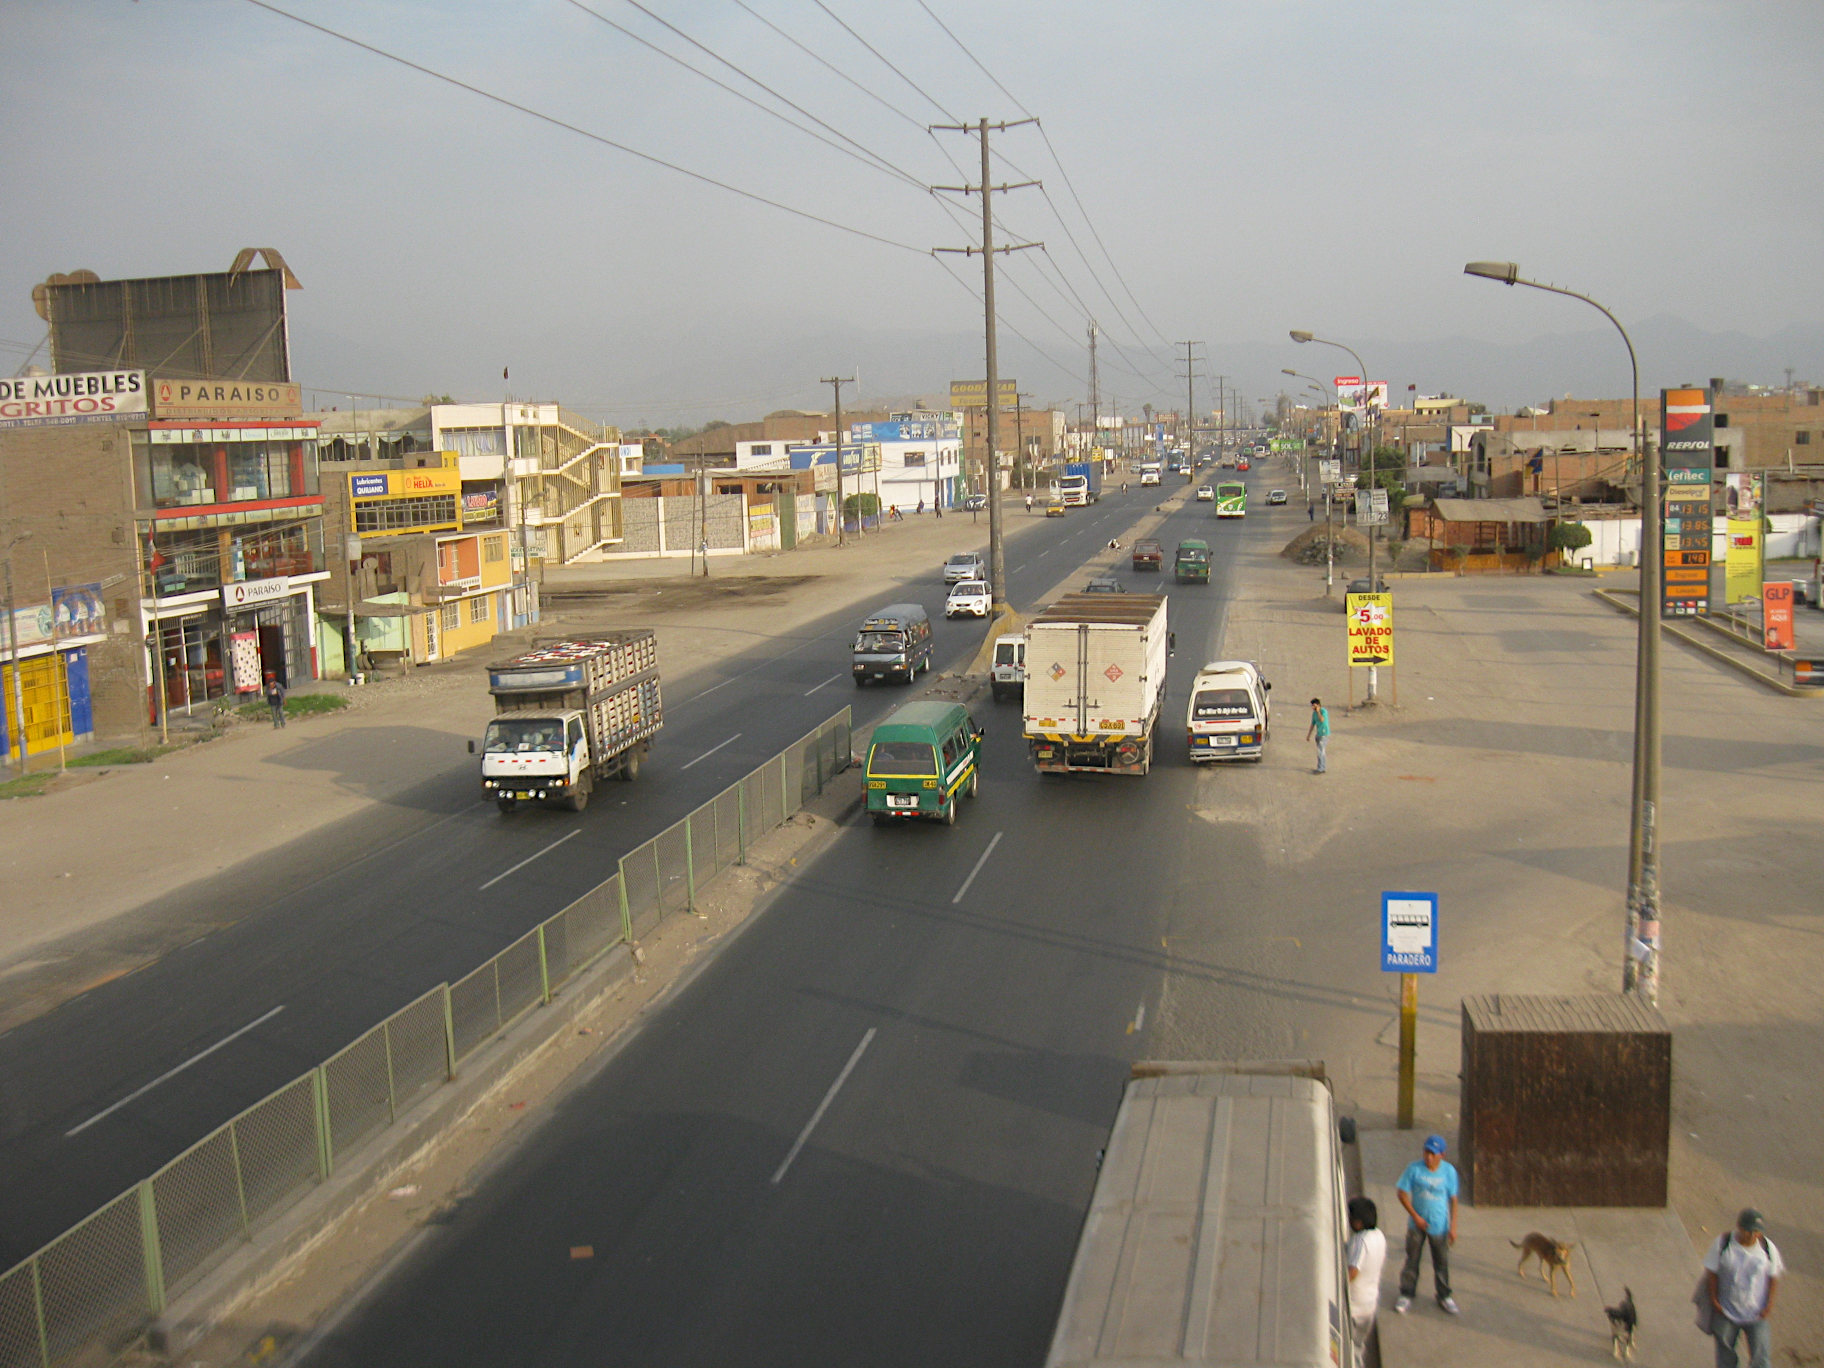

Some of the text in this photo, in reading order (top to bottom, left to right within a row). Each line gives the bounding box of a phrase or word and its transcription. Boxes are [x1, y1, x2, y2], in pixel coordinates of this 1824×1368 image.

[0, 373, 141, 400] DE MUEBLES
[951, 383, 1016, 393] GOODAR
[180, 385, 280, 401] PARAISO
[1666, 441, 1710, 450] REPSOL
[413, 480, 433, 489] HELIX
[1766, 588, 1790, 600] GLP
[1349, 627, 1392, 636] LAVADO
[1365, 637, 1379, 645] DE
[1353, 645, 1389, 654] AUTOS
[1387, 953, 1431, 966] PARADERO
